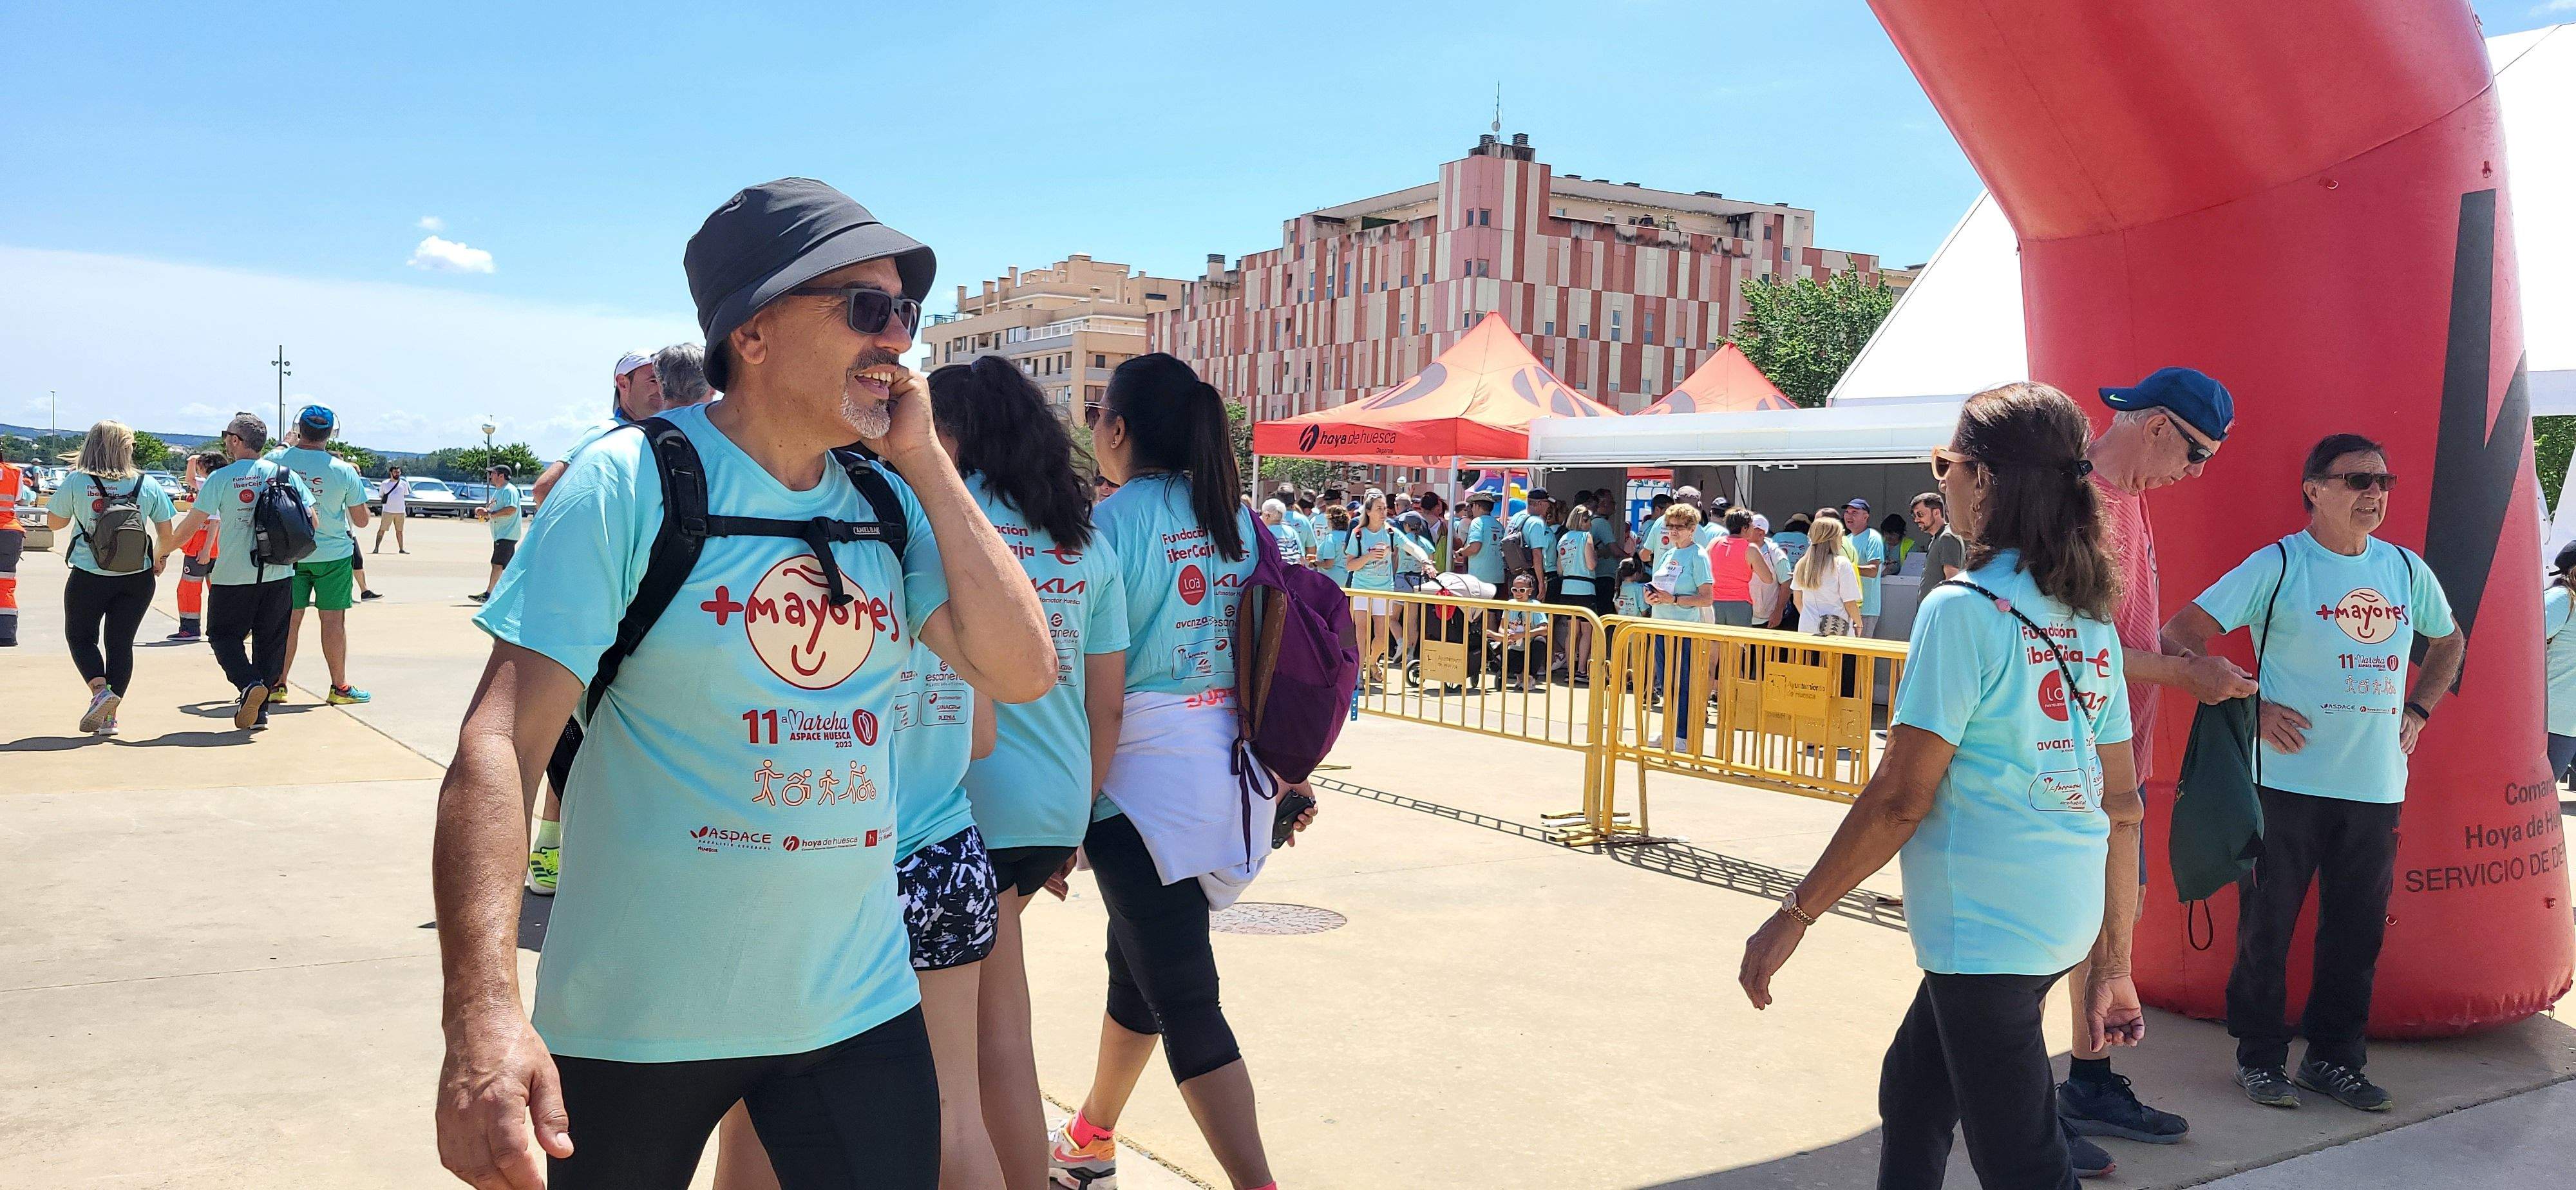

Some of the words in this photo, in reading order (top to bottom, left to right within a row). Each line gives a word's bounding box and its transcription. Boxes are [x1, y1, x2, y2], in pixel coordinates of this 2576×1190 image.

[1320, 431, 1347, 448] hoya
[1348, 431, 1359, 444] de
[1360, 430, 1397, 444] huesca
[853, 526, 880, 535] CAMELBAK
[742, 709, 779, 744] 11
[788, 708, 850, 731] Marcha
[790, 732, 821, 741] ASPACE
[824, 731, 851, 741] HUESCA
[708, 827, 772, 844] ASPACE
[2465, 824, 2522, 849] Hoya
[2526, 814, 2544, 839] de
[802, 839, 822, 848] hoya
[833, 836, 858, 845] huesca
[2405, 856, 2525, 893] SERVICIO
[2530, 849, 2550, 876] DE
